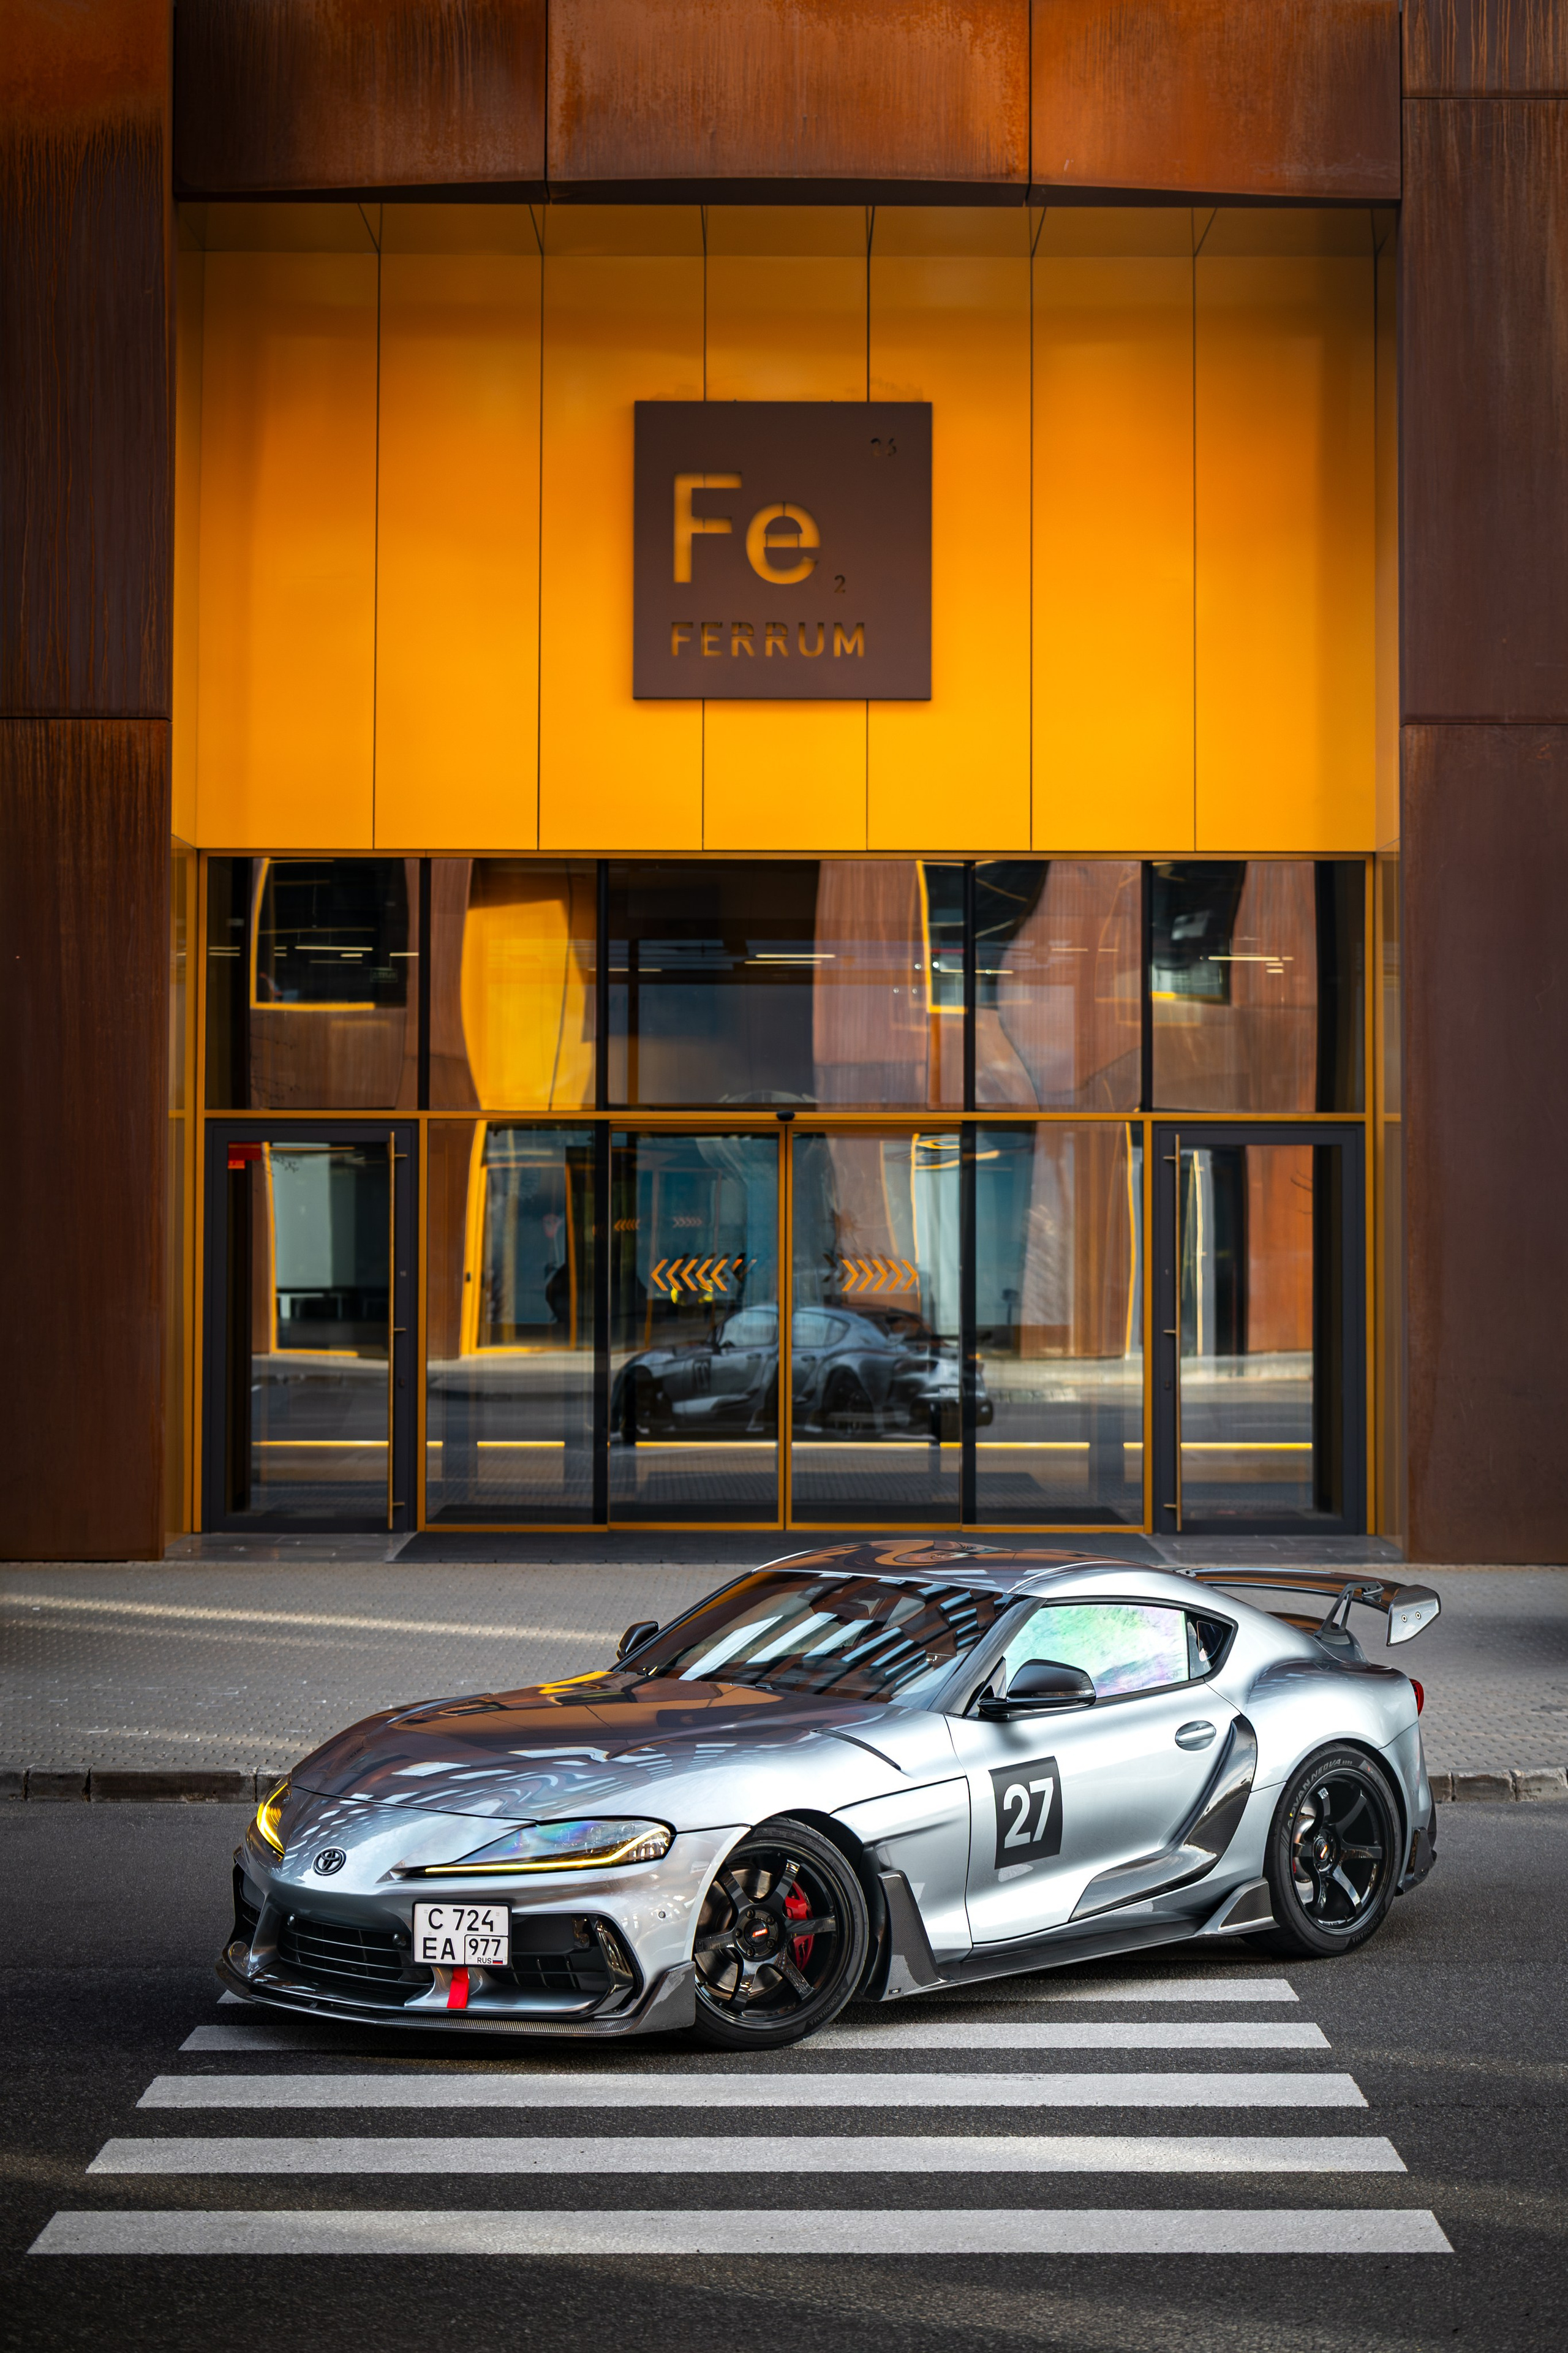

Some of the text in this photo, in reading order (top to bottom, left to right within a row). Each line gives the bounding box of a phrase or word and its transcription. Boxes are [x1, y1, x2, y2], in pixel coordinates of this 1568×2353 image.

[674, 470, 821, 585] Fe
[834, 574, 846, 594] 2
[671, 621, 865, 658] FERRUM
[1287, 1778, 1311, 1830] ADVAN
[1311, 1758, 1341, 1781] NEOVA
[1003, 1777, 1054, 1849] 27
[428, 1908, 494, 1932] C 724
[423, 1936, 456, 1960] EA
[469, 1938, 501, 1957] 977
[809, 1995, 841, 2025] YOKOHAMA
